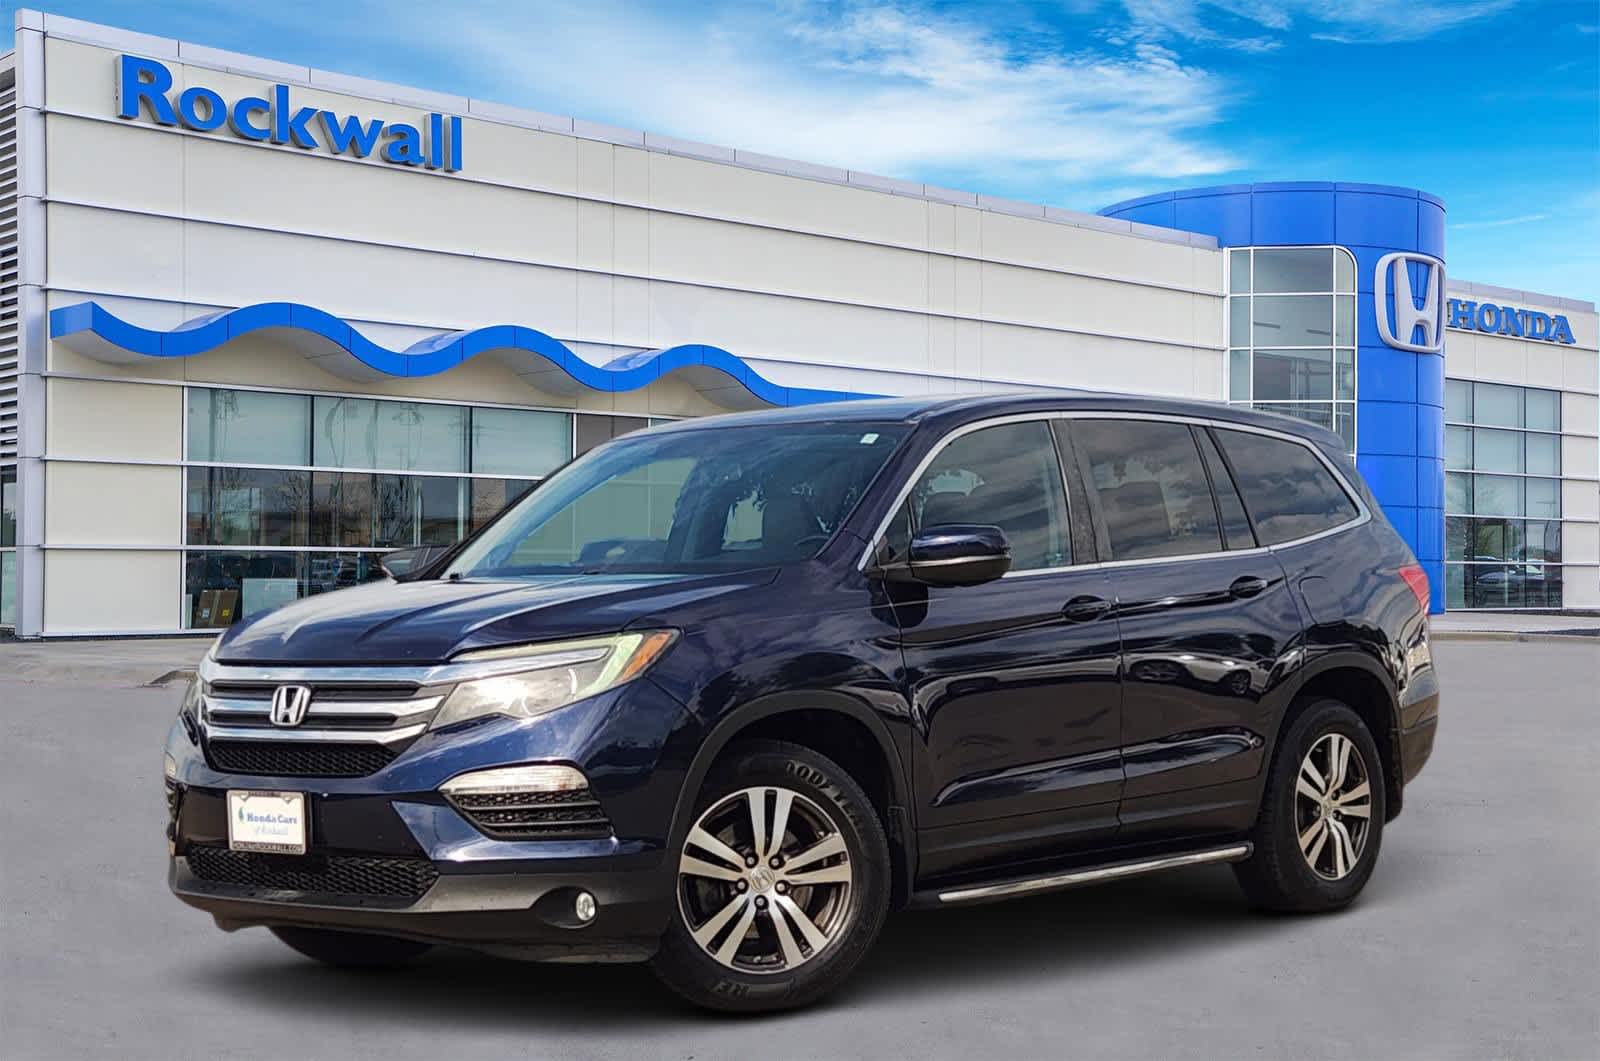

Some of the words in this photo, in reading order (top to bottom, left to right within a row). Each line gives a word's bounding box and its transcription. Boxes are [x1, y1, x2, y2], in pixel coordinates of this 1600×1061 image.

[118, 54, 463, 172] Rockwall
[1447, 298, 1577, 344] HONDA
[247, 812, 276, 823] Honda
